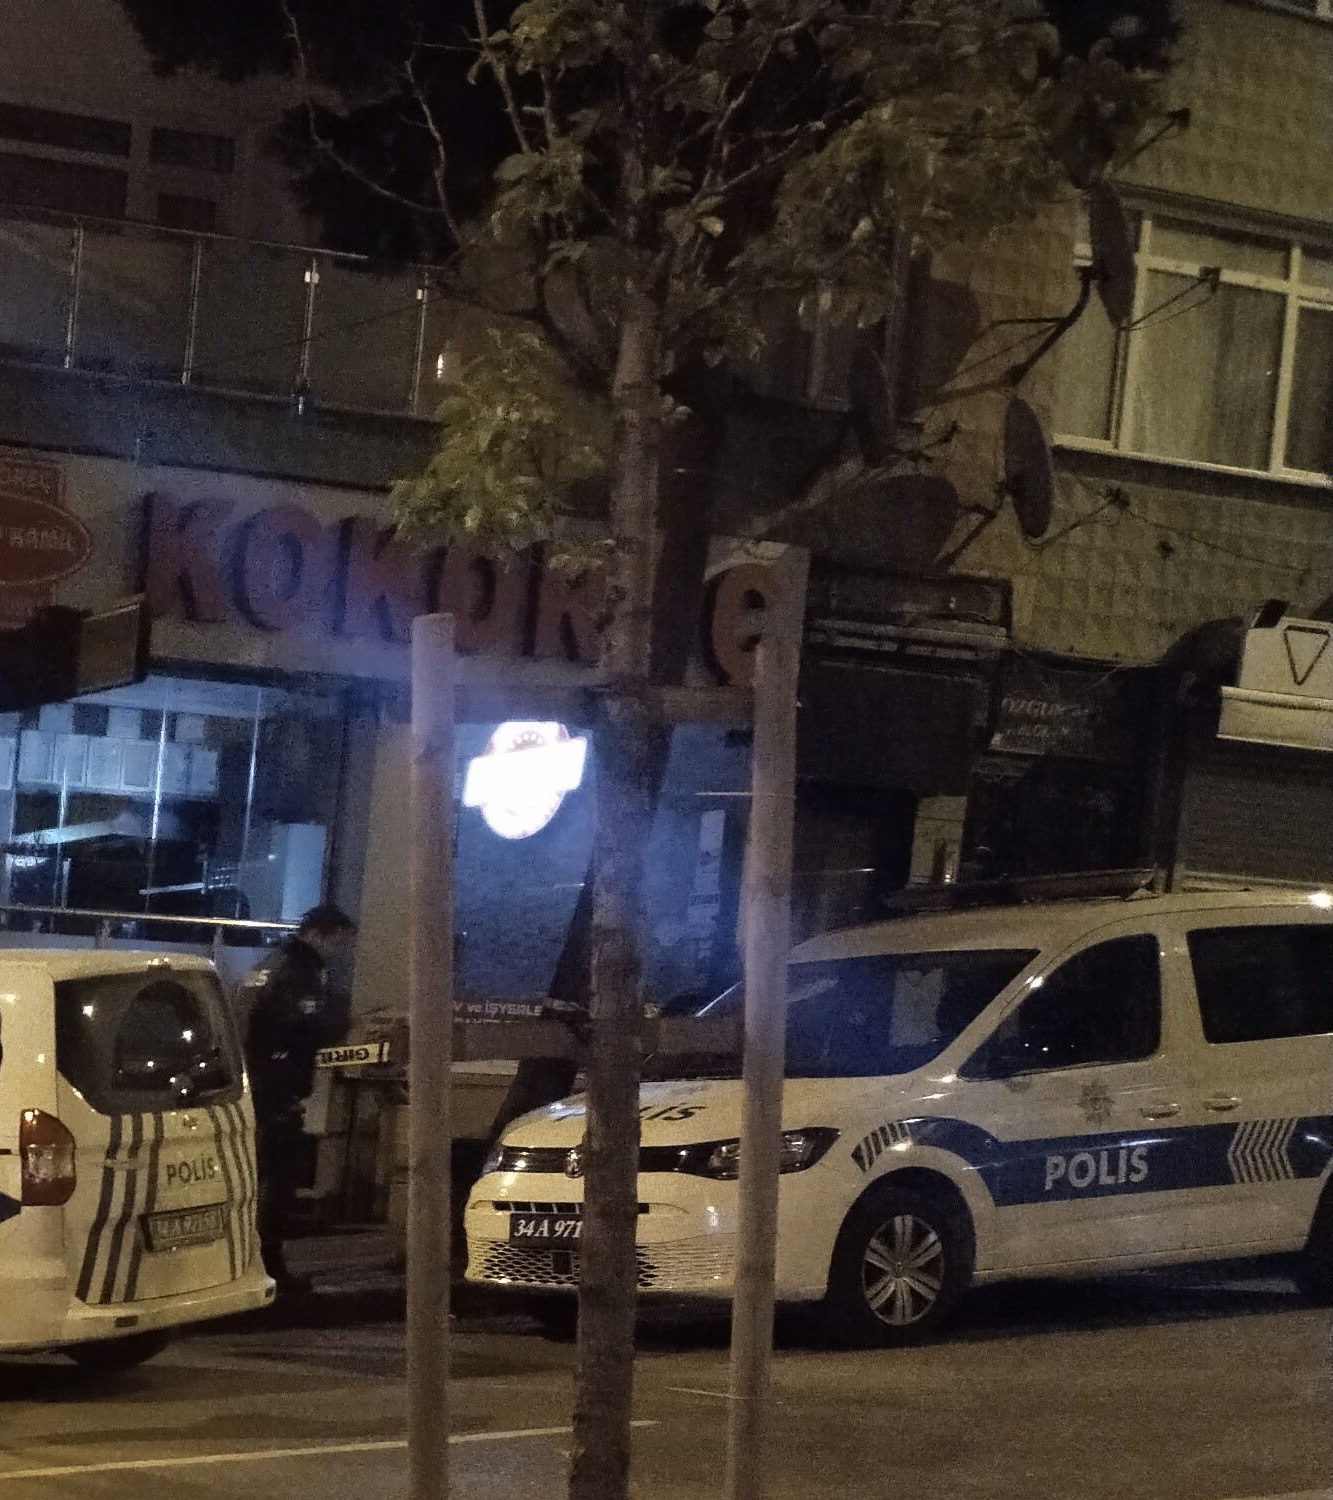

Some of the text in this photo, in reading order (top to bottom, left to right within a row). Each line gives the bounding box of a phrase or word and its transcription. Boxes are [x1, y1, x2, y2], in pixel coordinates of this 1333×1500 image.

[485, 1000, 543, 1018] İŞYERLE
[167, 1154, 217, 1186] POLİS
[1044, 1140, 1149, 1191] POLİS
[514, 1218, 583, 1238] 34 A 971
